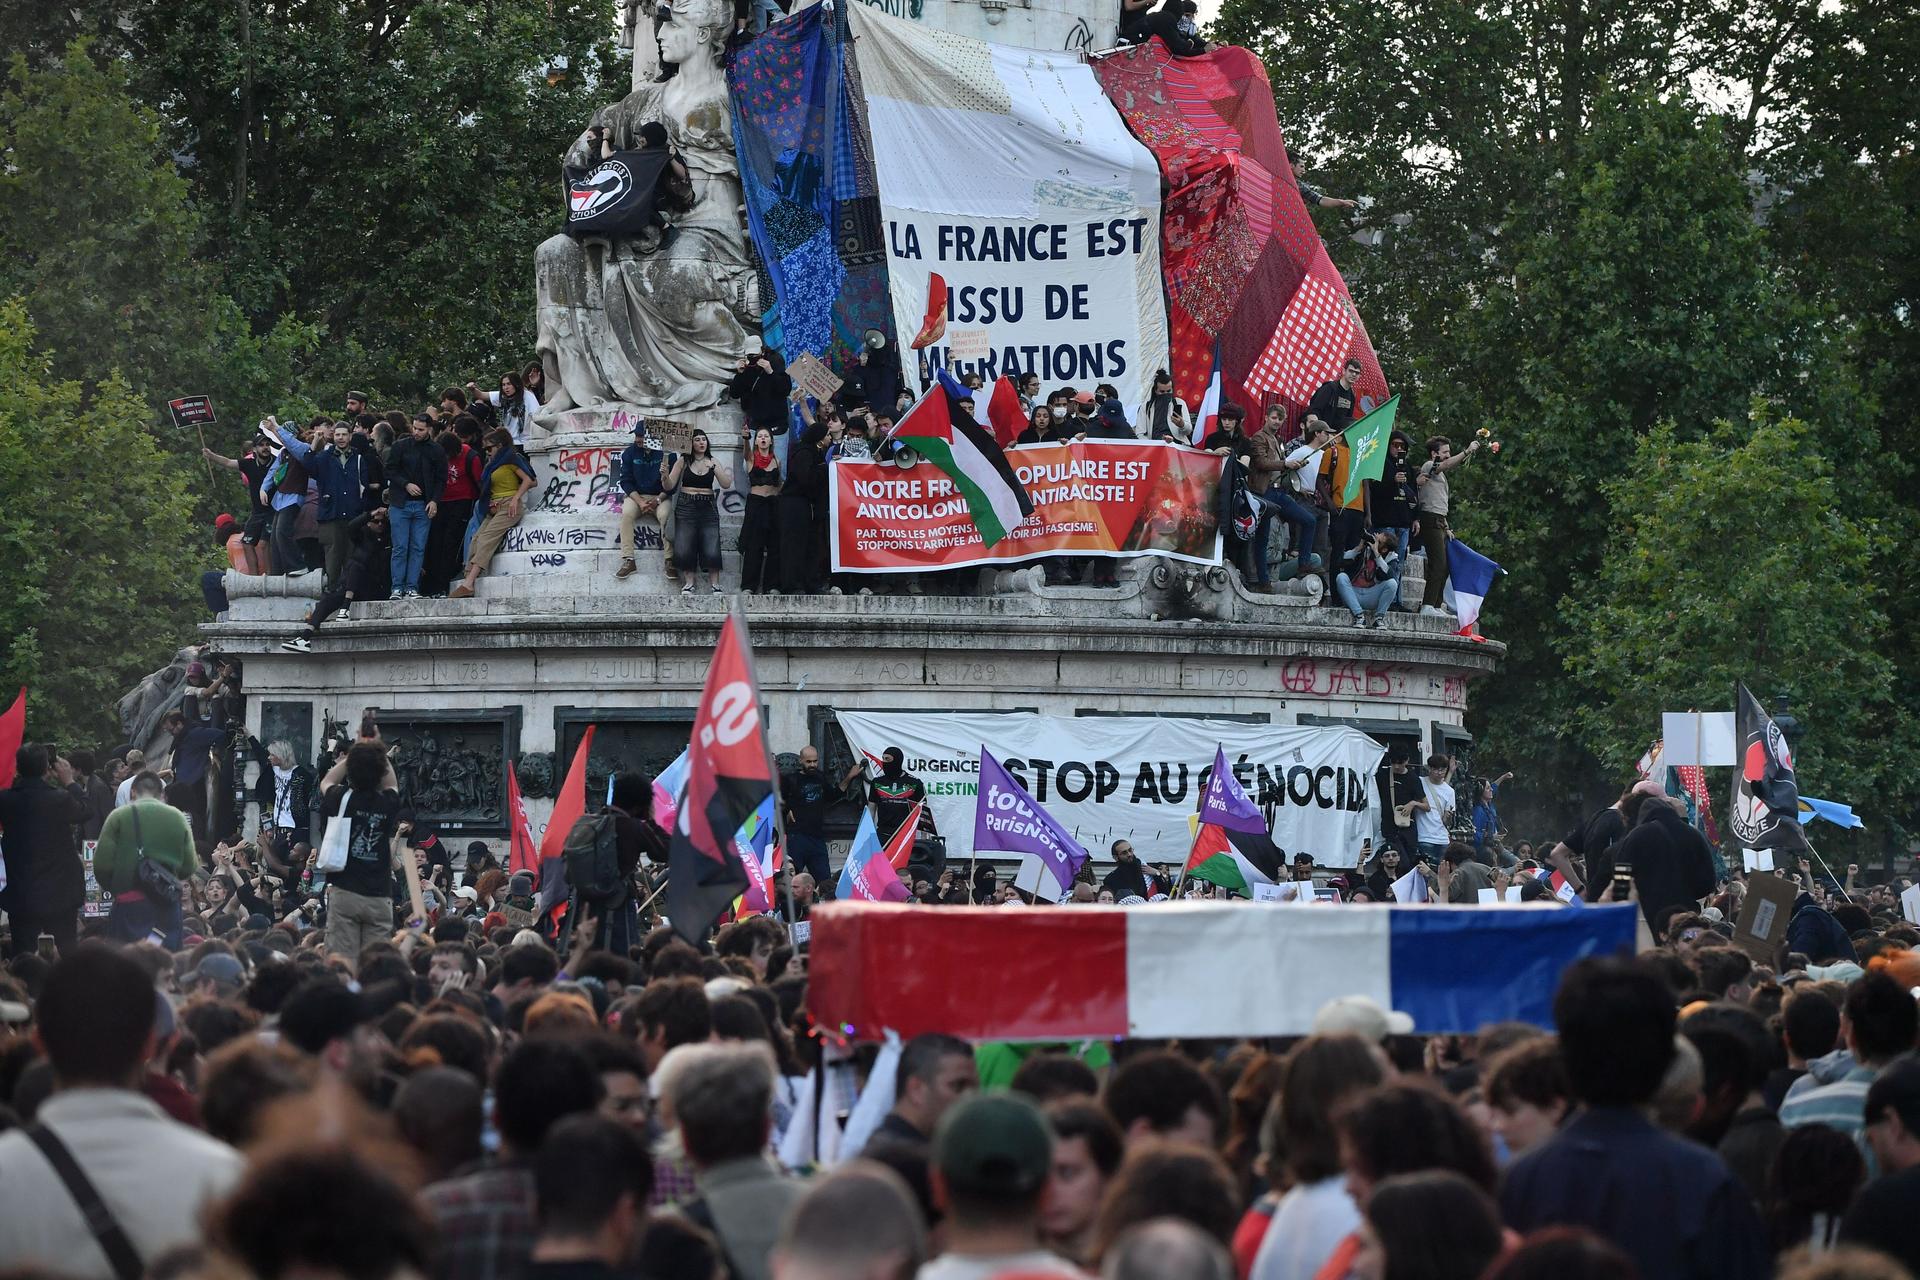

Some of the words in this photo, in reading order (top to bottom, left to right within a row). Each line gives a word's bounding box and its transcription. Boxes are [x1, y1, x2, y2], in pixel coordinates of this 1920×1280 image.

[890, 222, 922, 259] LA
[938, 225, 1067, 262] FRANCE
[1087, 218, 1147, 257] EST
[947, 286, 1023, 324] ISSU
[1045, 284, 1089, 321] DE
[853, 480, 921, 499] NOTRE
[928, 480, 960, 498] FR
[1015, 459, 1109, 485] OPULAIRE
[1115, 461, 1150, 481] EST
[856, 499, 970, 520] ANTICOLONI
[1029, 484, 1125, 506] NTIRACISTE
[856, 529, 877, 538] PAR
[881, 529, 907, 539] TOUS
[909, 530, 926, 539] LES
[928, 524, 972, 538] MOYENS
[856, 541, 914, 550] STOPPONS
[916, 537, 965, 550] L'ARRIVÉE
[968, 535, 983, 544] AU
[1003, 530, 1029, 540] VOIR
[1032, 527, 1044, 537] DU
[457, 663, 488, 680] 1789
[584, 661, 599, 679] 14
[606, 661, 684, 680] JUILLET
[692, 661, 711, 679] 17
[854, 664, 865, 679] 4
[954, 663, 997, 681] 1789
[1107, 666, 1124, 683] 14
[1131, 666, 1204, 685] JUILLET
[1211, 667, 1249, 687] 1790
[907, 758, 979, 773] URGENCE
[927, 783, 978, 796] LESTIN
[1002, 758, 1120, 804] STOP
[1130, 761, 1188, 805] AU
[985, 813, 1068, 864] ParisNord
